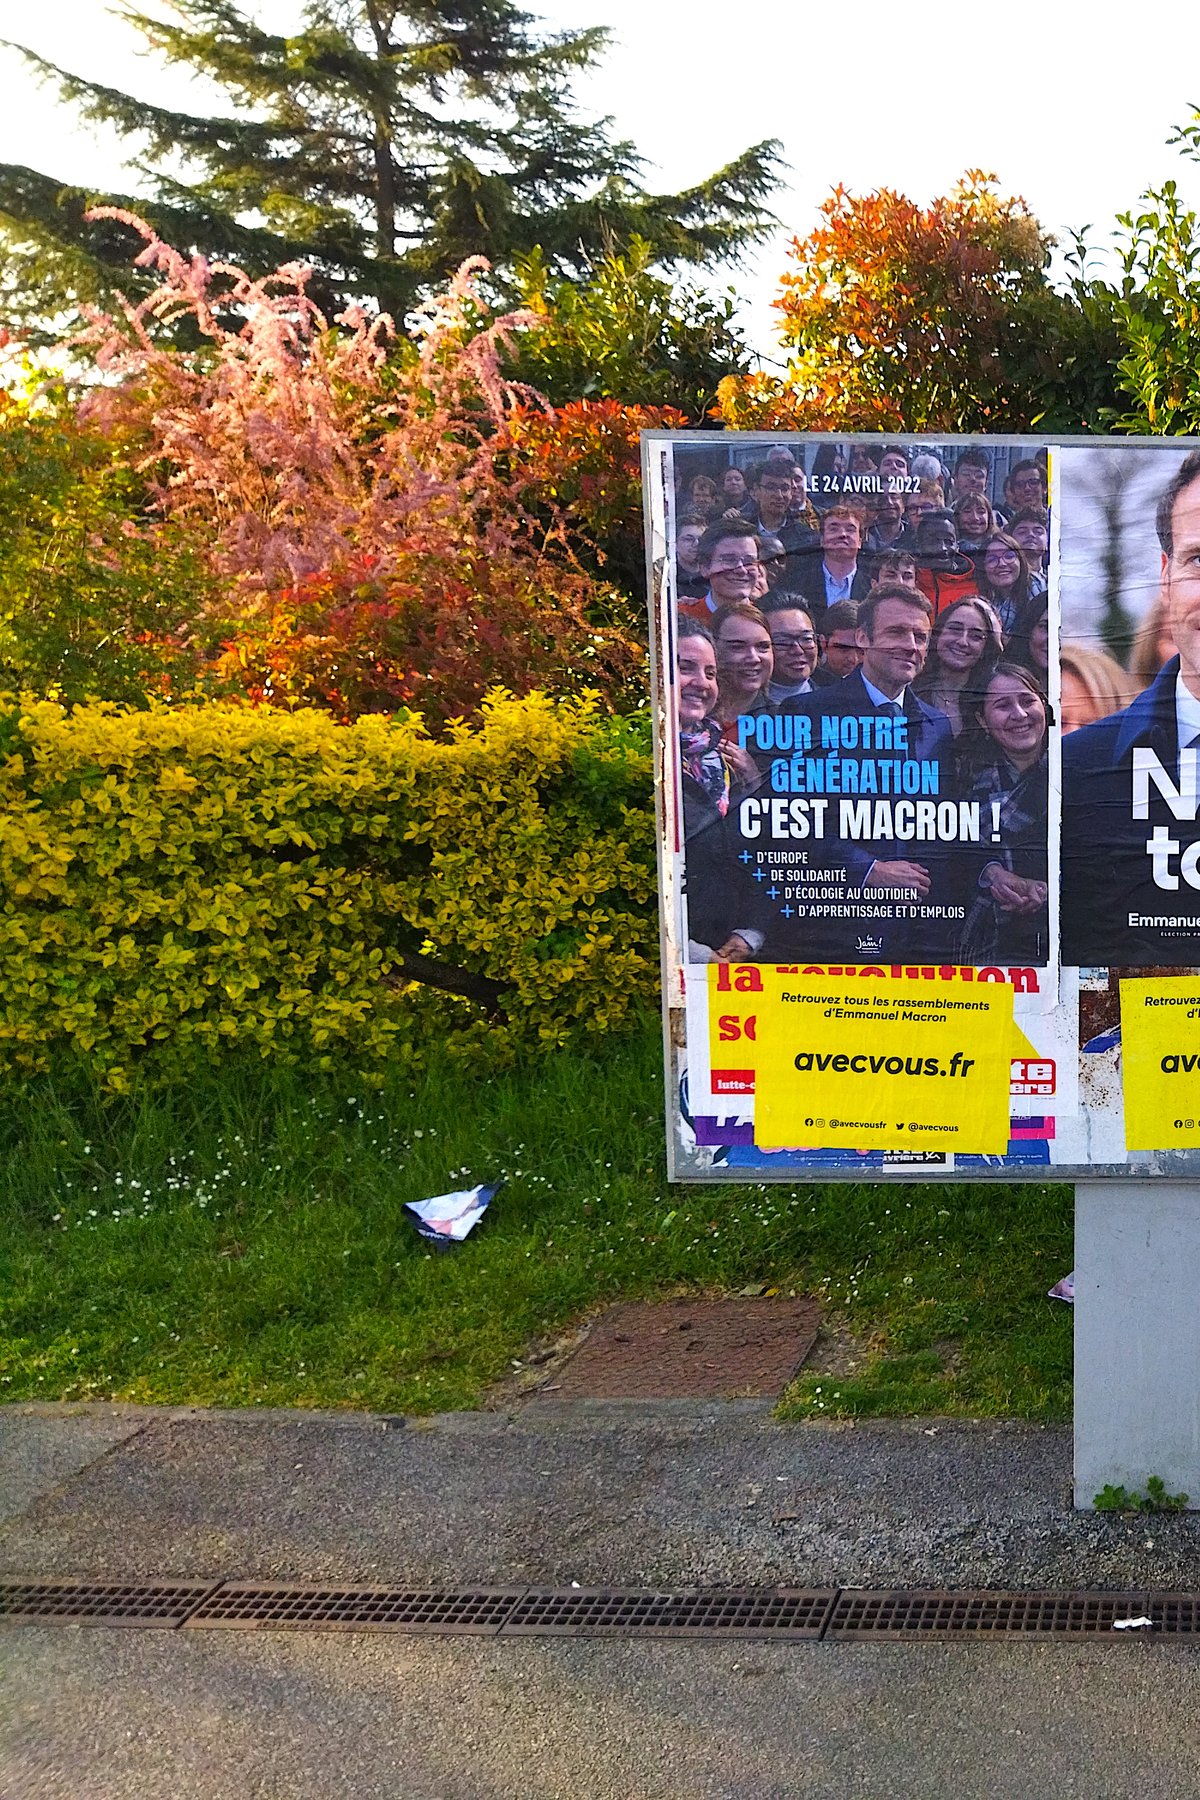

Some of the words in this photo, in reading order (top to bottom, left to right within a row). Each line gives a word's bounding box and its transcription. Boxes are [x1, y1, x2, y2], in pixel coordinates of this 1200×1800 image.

[804, 475, 819, 493] LE
[823, 476, 839, 492] 24
[843, 476, 885, 492] AVRIL
[888, 476, 921, 493] 2022
[738, 715, 812, 750] POUR
[822, 716, 908, 750] NOTRE
[771, 750, 939, 795] GÉNÉRATION
[740, 798, 828, 838] C'EST
[840, 800, 979, 841] MACRON
[991, 802, 1001, 841] !
[757, 852, 808, 863] D'EUROPE
[771, 870, 784, 881] DE
[787, 868, 846, 881] SOLIDARITÉ
[785, 885, 844, 899] D'ÉCOLOGIE
[847, 888, 860, 899] AU
[864, 888, 917, 900] QUOTIDIEN
[799, 905, 892, 917] D'APPRENTISSAGE
[896, 906, 907, 917] ET
[910, 906, 964, 918] D'EMPLOIS
[782, 993, 840, 1004] Retrouvez
[845, 996, 869, 1005] tous
[873, 996, 889, 1006] les
[892, 997, 990, 1012] rassemblements
[902, 1011, 946, 1022] Macron
[795, 1052, 974, 1077] avecvous.fr
[830, 1120, 886, 1128] @avecvousfr
[908, 1123, 958, 1132] @avecvous
